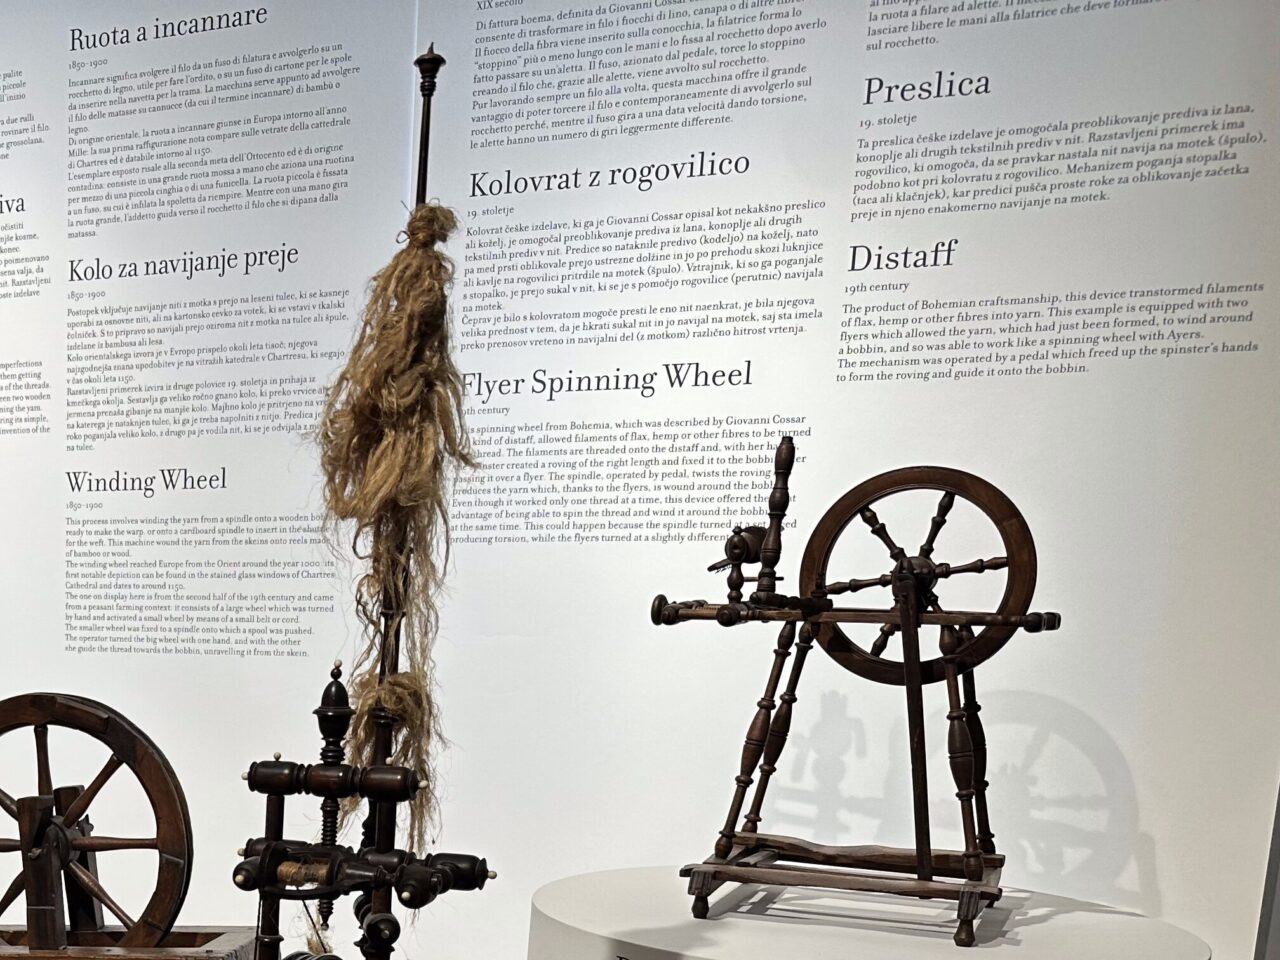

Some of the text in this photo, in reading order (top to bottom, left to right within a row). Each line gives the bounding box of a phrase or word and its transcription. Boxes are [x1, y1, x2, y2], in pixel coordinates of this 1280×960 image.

[69, 7, 268, 51] Ruota a incannare
[866, 35, 939, 51] sul rocchetto.
[863, 71, 991, 105] Preslica
[470, 115, 733, 150] le alette hanno un numero di giri leggermente differente.
[877, 113, 917, 127] stoletje
[469, 151, 750, 197] Kolovrat z rogovilico
[481, 206, 514, 218] stoletje
[850, 190, 1109, 222] preje in njeno enakomerno navijanje na motek.
[68, 243, 299, 282] Kolo za navijanje preje
[847, 238, 959, 272] Distaff
[844, 282, 909, 296] 19th century
[462, 305, 473, 313] na
[460, 338, 485, 353] preko
[486, 339, 528, 352] prenosov
[528, 337, 564, 347] vreteno
[565, 335, 575, 345] in
[577, 332, 617, 347] navijalni
[635, 331, 645, 344] (z
[646, 328, 690, 342] motkom)
[692, 327, 731, 339] različno
[733, 326, 766, 337] hitrost
[838, 341, 1258, 369] The mechanism was operated by a pedal which freed up the spinster's hands
[462, 360, 753, 404] Flyer Spinning Wheel
[836, 362, 1088, 383] to form the roving and guide it onto the bobbin.
[476, 423, 516, 437] spinning
[516, 421, 543, 433] wheel
[545, 421, 568, 432] from
[570, 420, 613, 432] Bohemia,
[614, 418, 643, 430] which
[644, 421, 662, 429] was
[663, 416, 710, 429] described
[712, 416, 723, 430] by
[725, 415, 770, 426] Giovanni
[772, 414, 806, 425] Cossar
[477, 406, 510, 418] century
[65, 467, 228, 498] Winding Wheel
